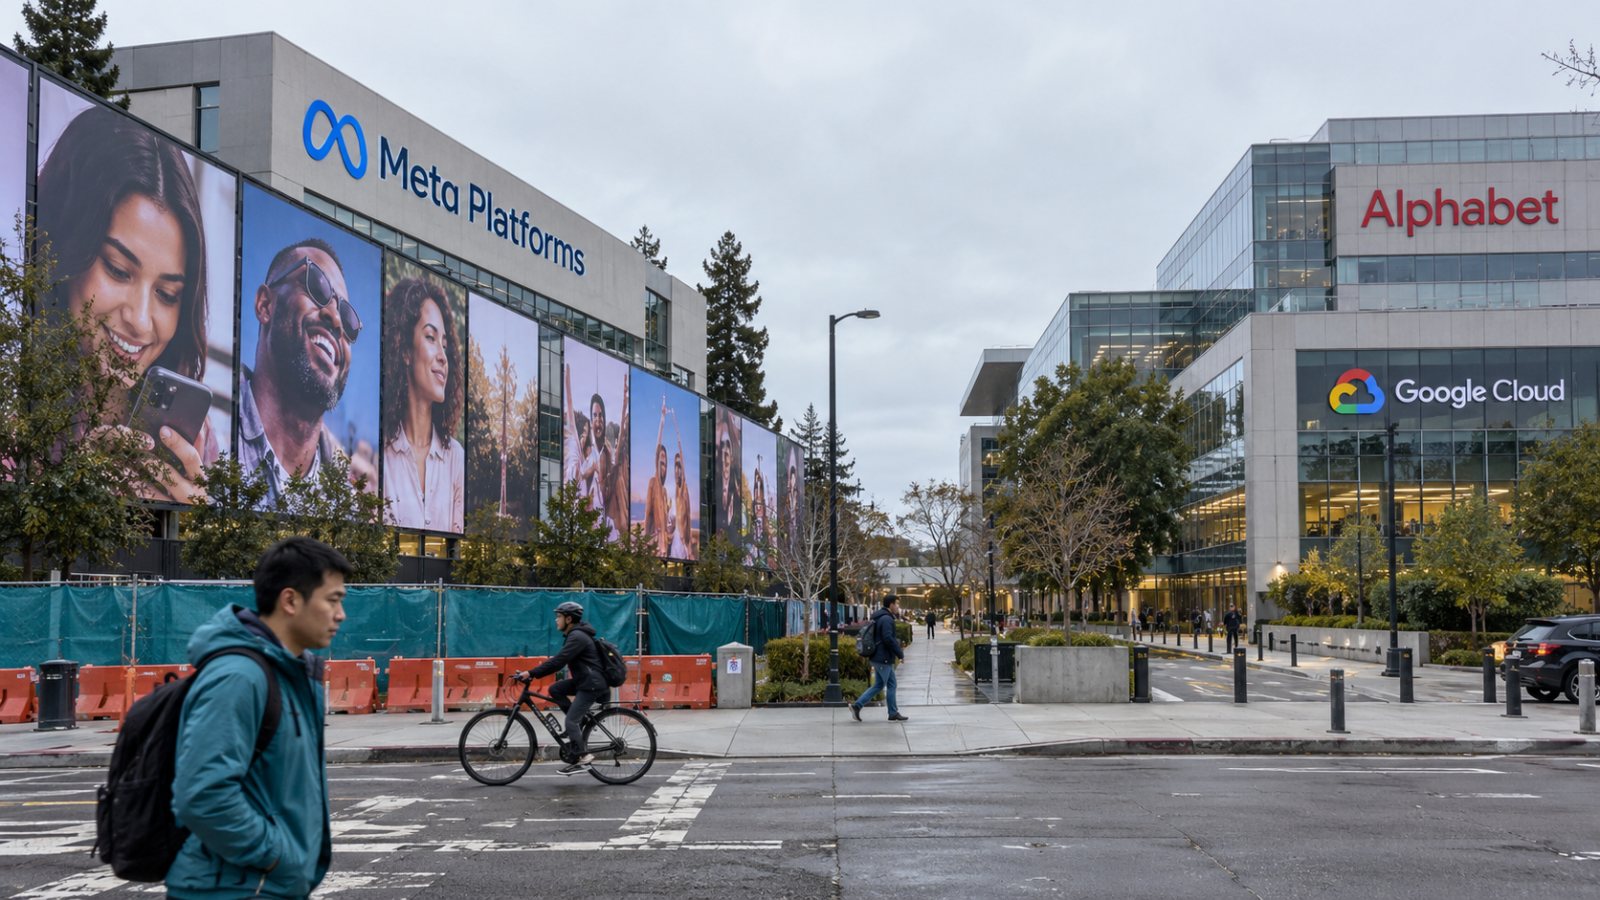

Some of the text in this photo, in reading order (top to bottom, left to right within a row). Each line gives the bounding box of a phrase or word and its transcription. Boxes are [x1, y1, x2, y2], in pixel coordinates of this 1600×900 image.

[379, 135, 586, 278] Meta Platforms
[1360, 186, 1560, 238] Alphabet
[1395, 378, 1565, 409] Google Cloud
